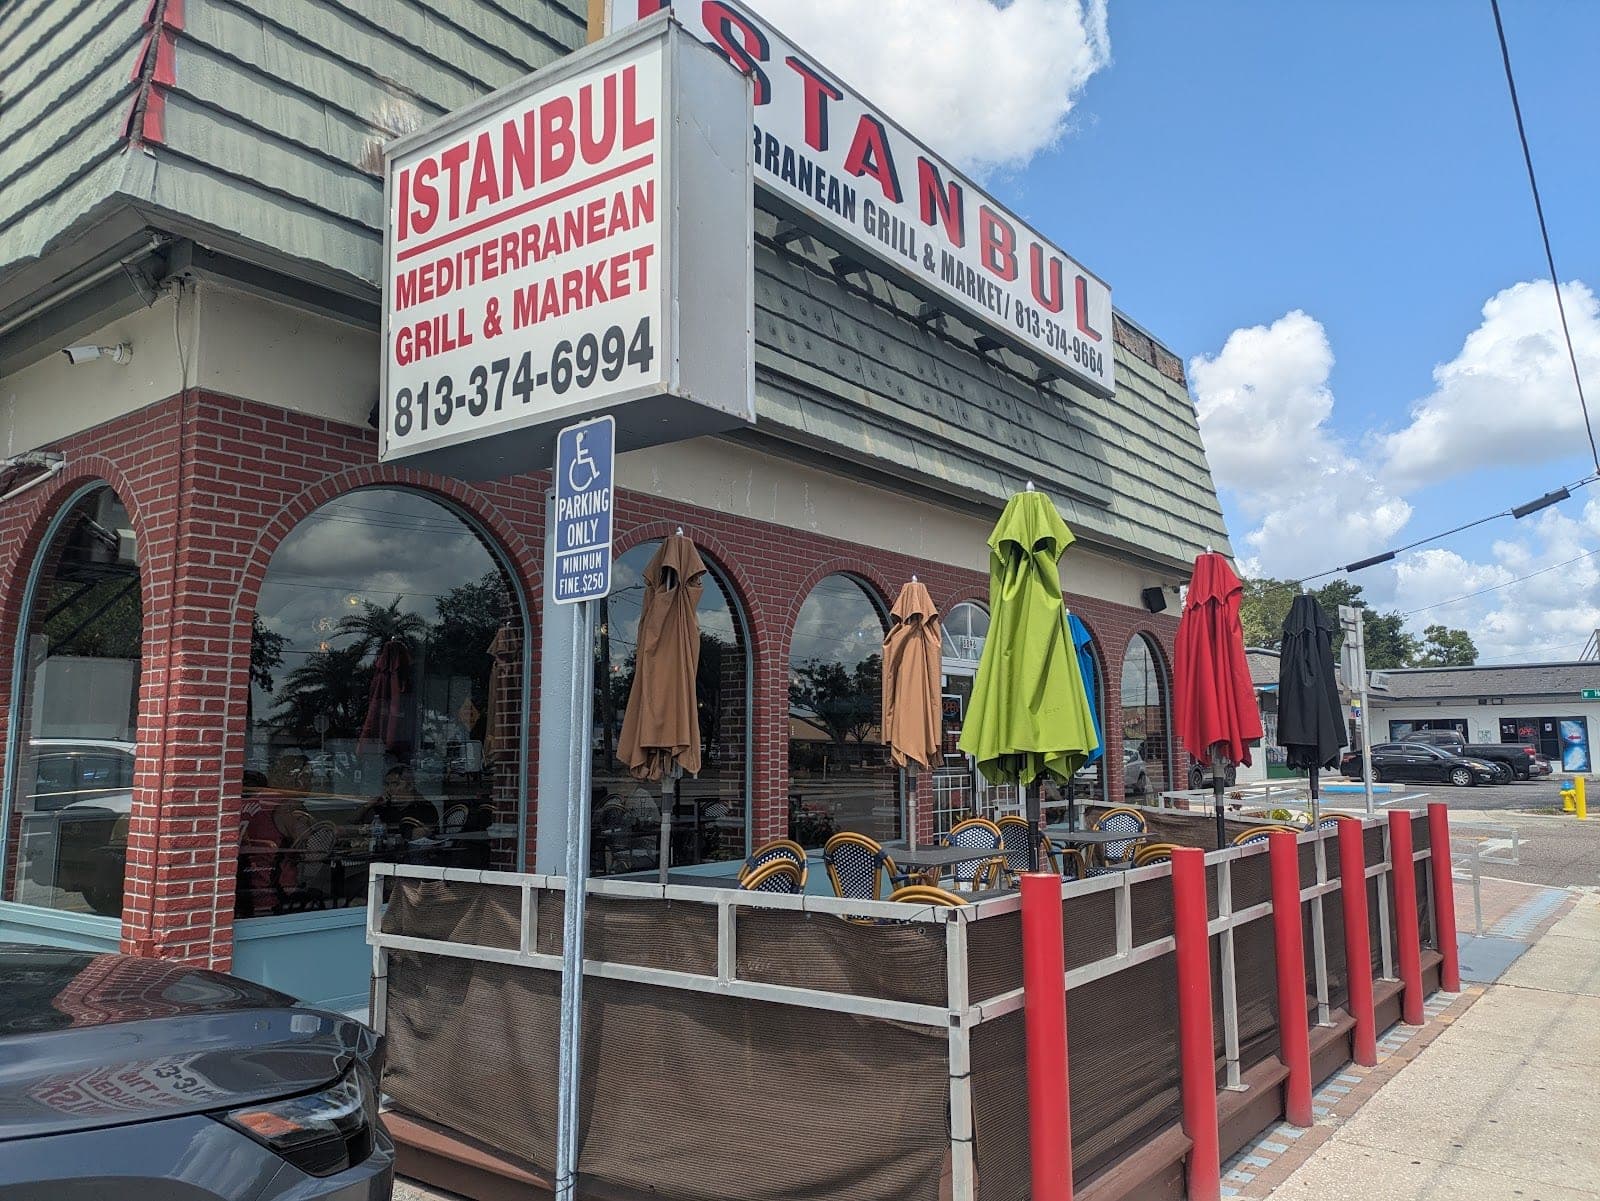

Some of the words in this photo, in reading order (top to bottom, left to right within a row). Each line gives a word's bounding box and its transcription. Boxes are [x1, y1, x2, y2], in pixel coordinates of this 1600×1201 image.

[398, 65, 655, 242] ISTANBUL
[638, 0, 1103, 342] STANBUL
[395, 308, 473, 366] GRILL
[483, 296, 503, 340] &
[513, 243, 654, 331] MARKET
[396, 179, 655, 311] MEDITERRANEAN
[863, 198, 917, 262] GRILL
[922, 242, 936, 273] &
[1015, 299, 1104, 378] 813-374-9664
[394, 316, 654, 437] 813-374-6994
[559, 488, 609, 522] PARKING
[563, 552, 602, 574] MINIMUM
[567, 518, 598, 546] ONLY
